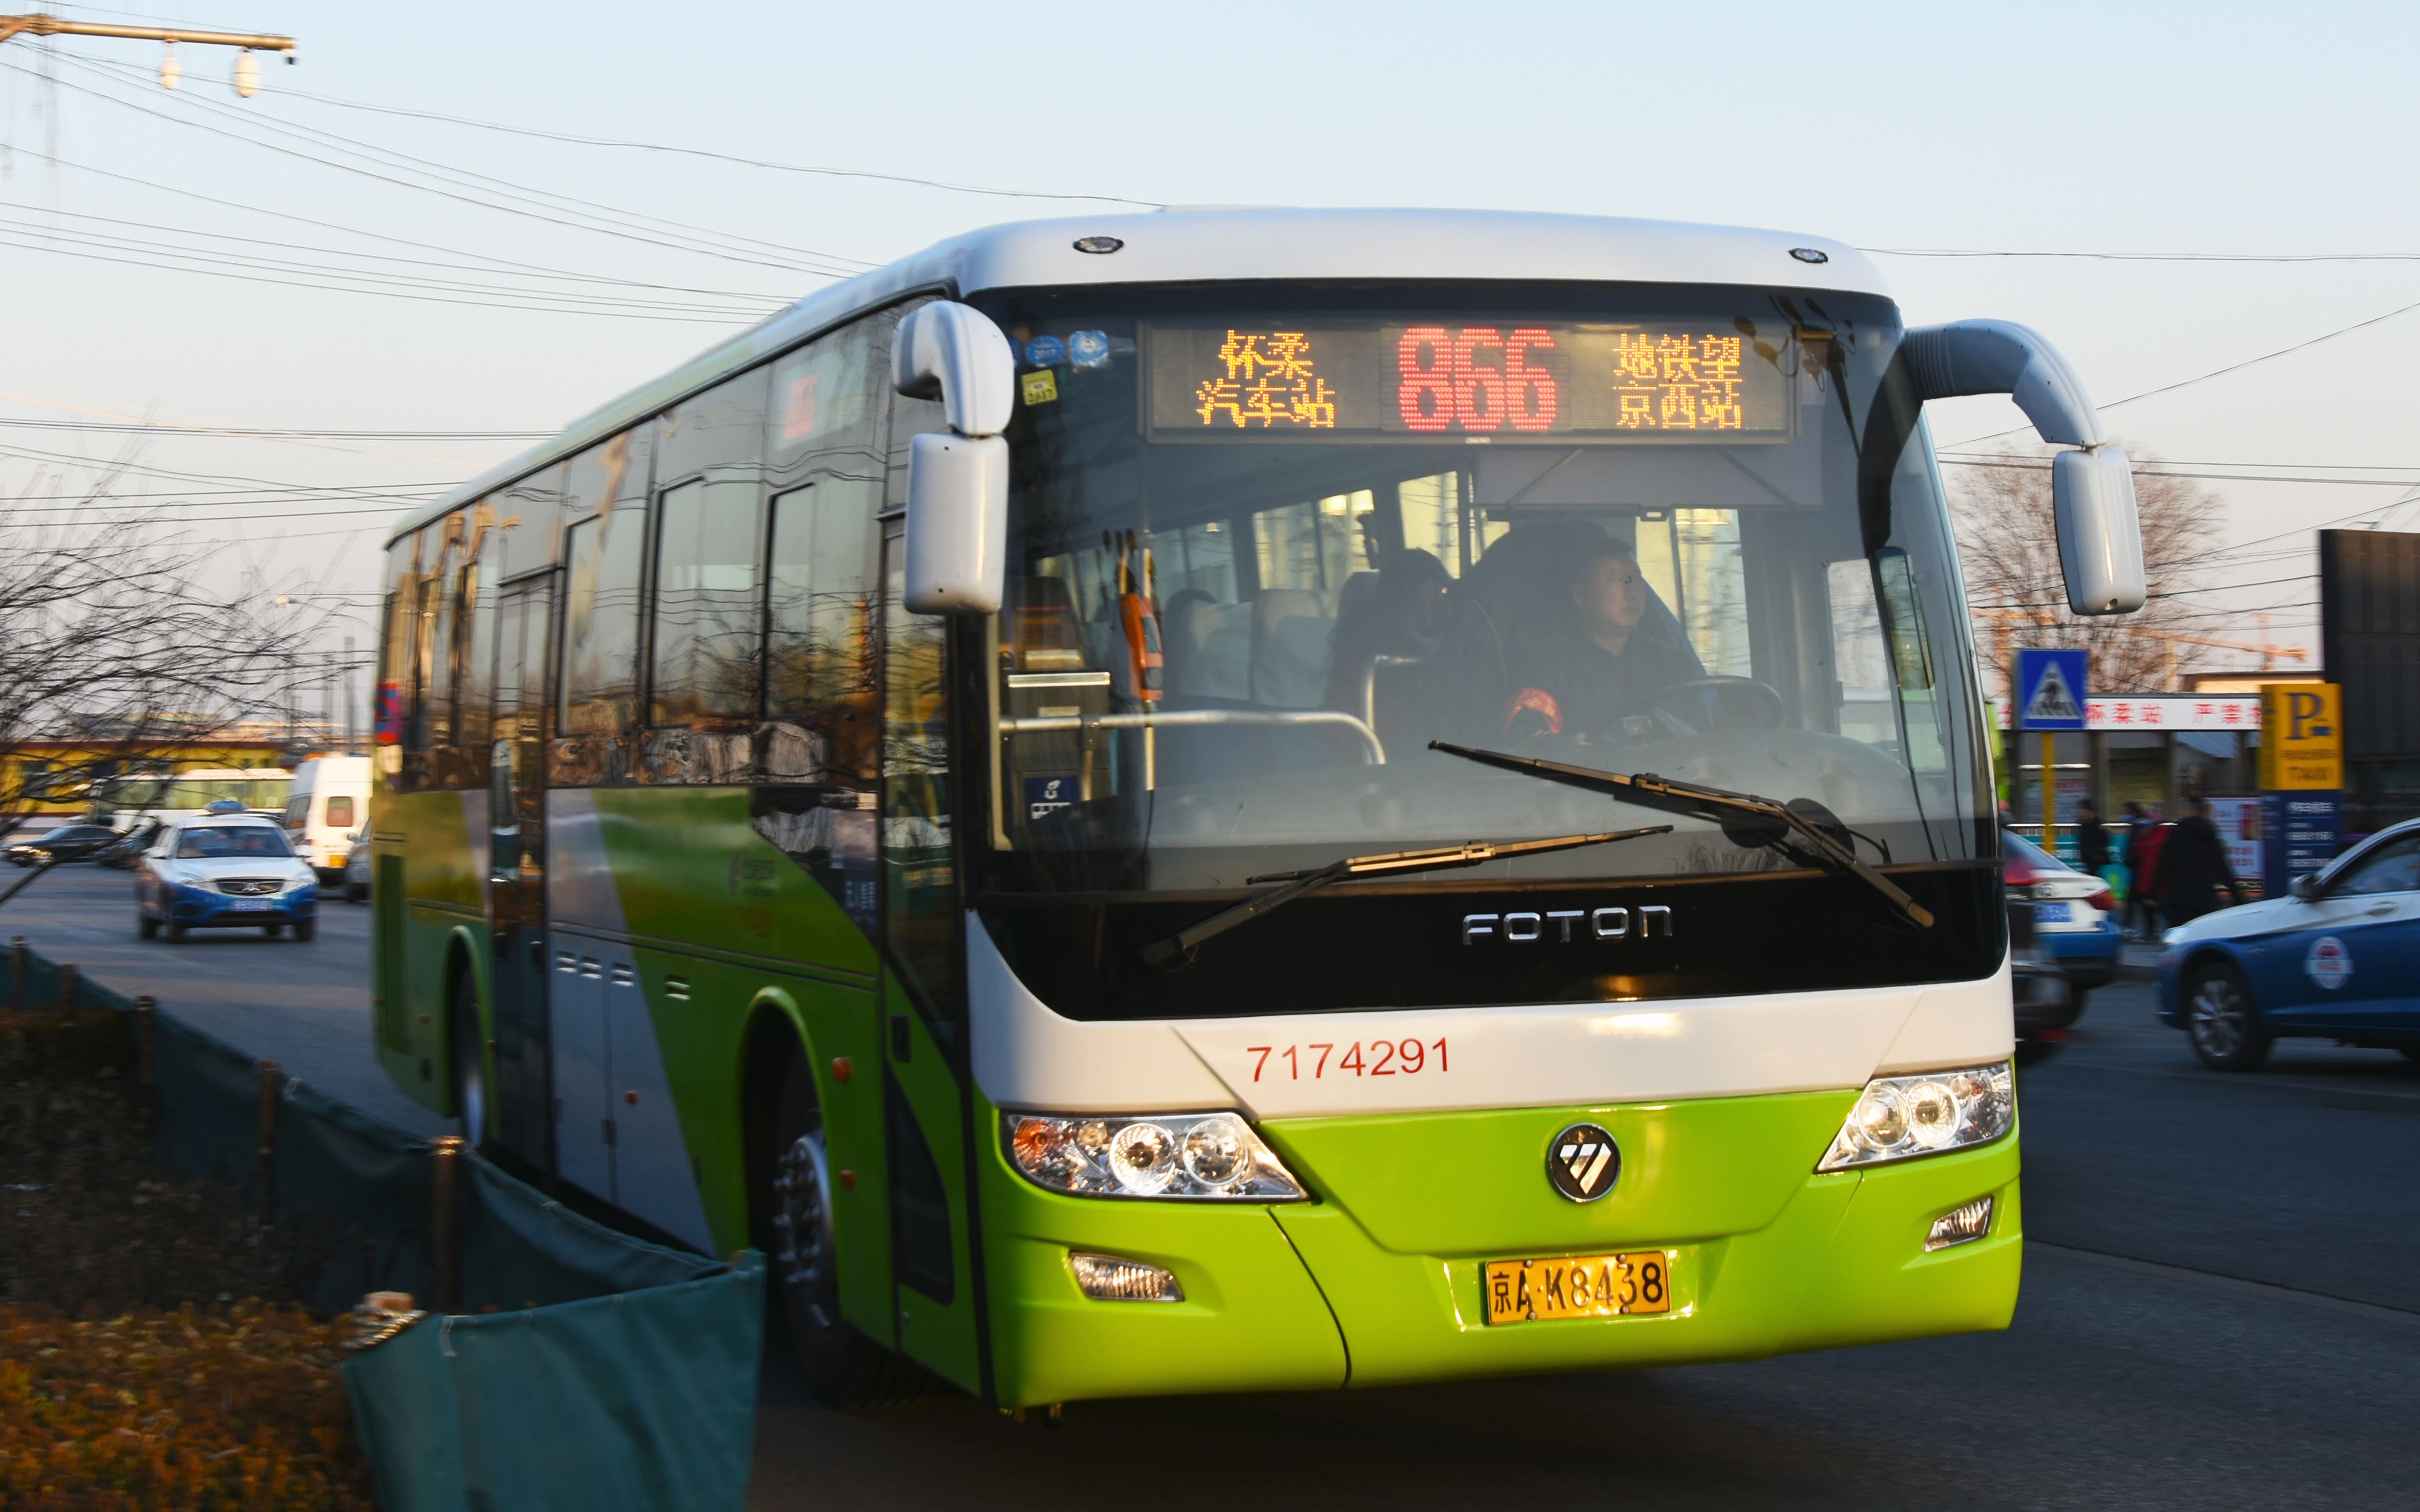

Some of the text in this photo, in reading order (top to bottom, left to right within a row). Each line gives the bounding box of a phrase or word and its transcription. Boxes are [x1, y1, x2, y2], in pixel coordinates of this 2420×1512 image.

[1218, 330, 1313, 380] 怀柔
[1399, 328, 1556, 430] 866
[1613, 334, 1742, 382] 地铁望
[1196, 378, 1335, 428] 汽车站
[1613, 380, 1741, 428] 京西站
[2285, 692, 2325, 740] P
[1463, 905, 1673, 945] FOTON
[1246, 1036, 1448, 1082] 7174291
